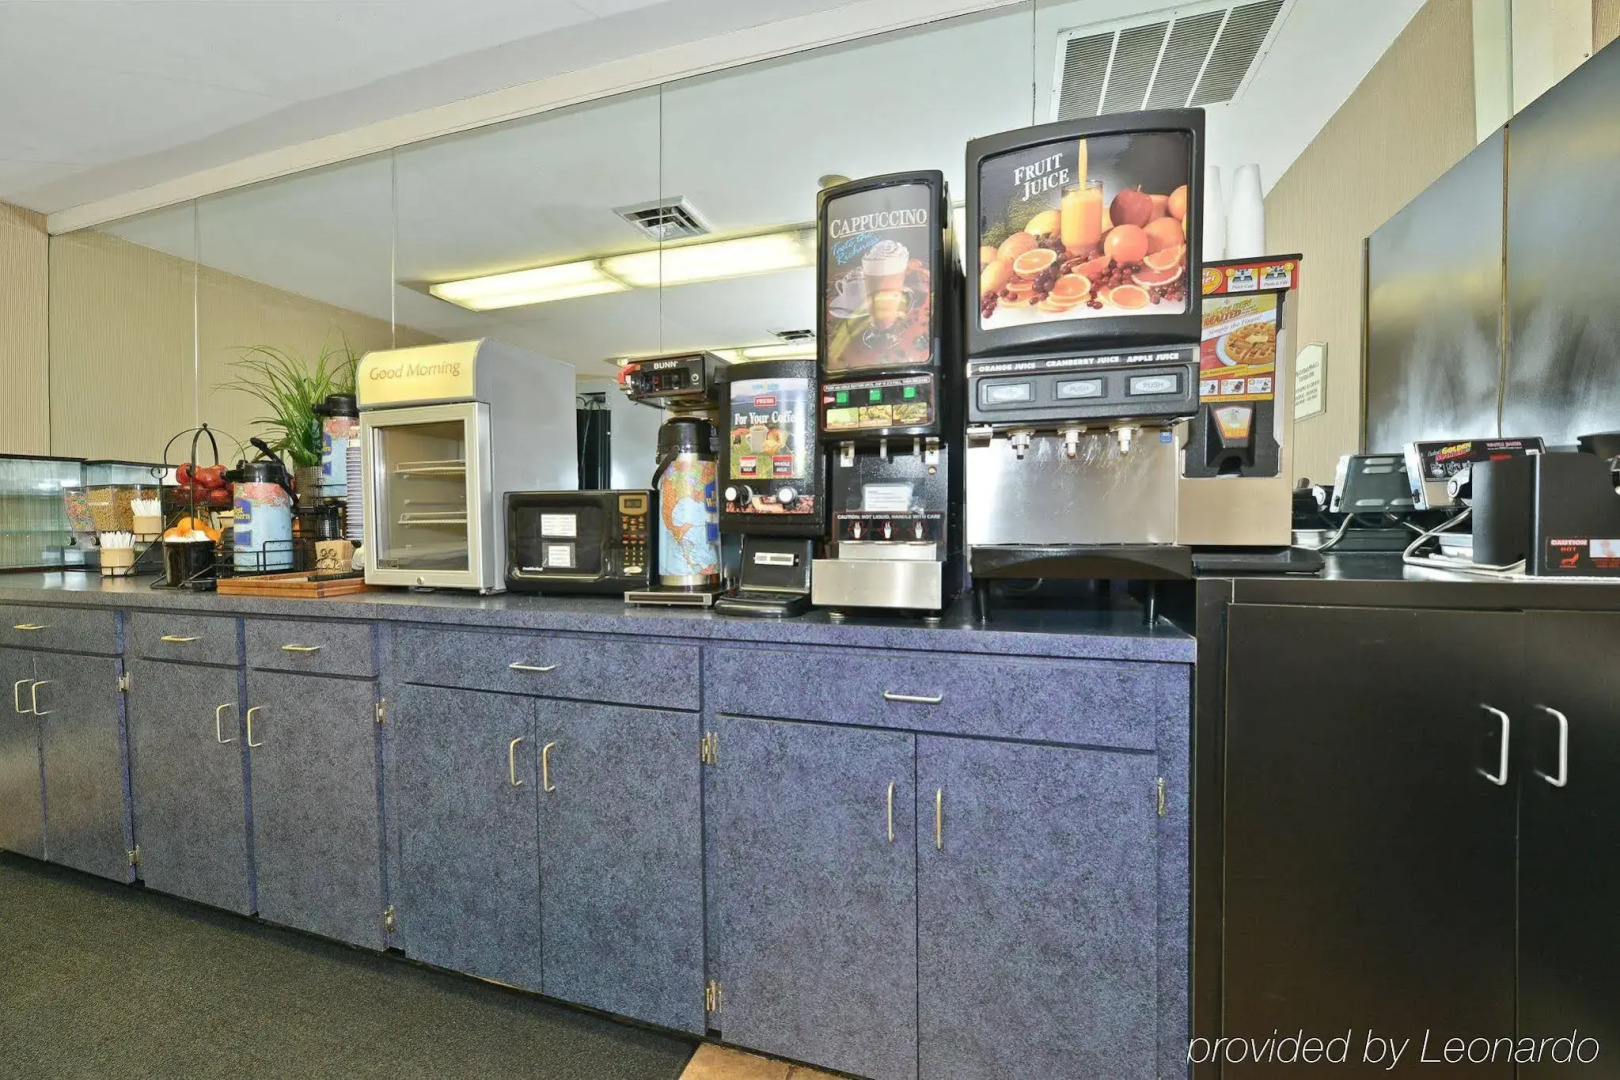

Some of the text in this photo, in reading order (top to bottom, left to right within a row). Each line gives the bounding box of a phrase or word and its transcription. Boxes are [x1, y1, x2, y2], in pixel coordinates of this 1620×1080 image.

[1013, 153, 1063, 186] FRUIT
[1021, 168, 1069, 201] JUICE
[829, 208, 927, 238] CAPPUCCINO
[1045, 356, 1120, 368] CRANBERRY JUICE
[1126, 352, 1179, 363] APPLE JUICE
[369, 361, 461, 381] Good Morning
[653, 361, 677, 370] BUNN
[978, 362, 1036, 373] ORANGE JUICE
[1069, 384, 1090, 393] PUSH
[1143, 380, 1164, 389] PUSH
[734, 410, 797, 426] For Your Coffe
